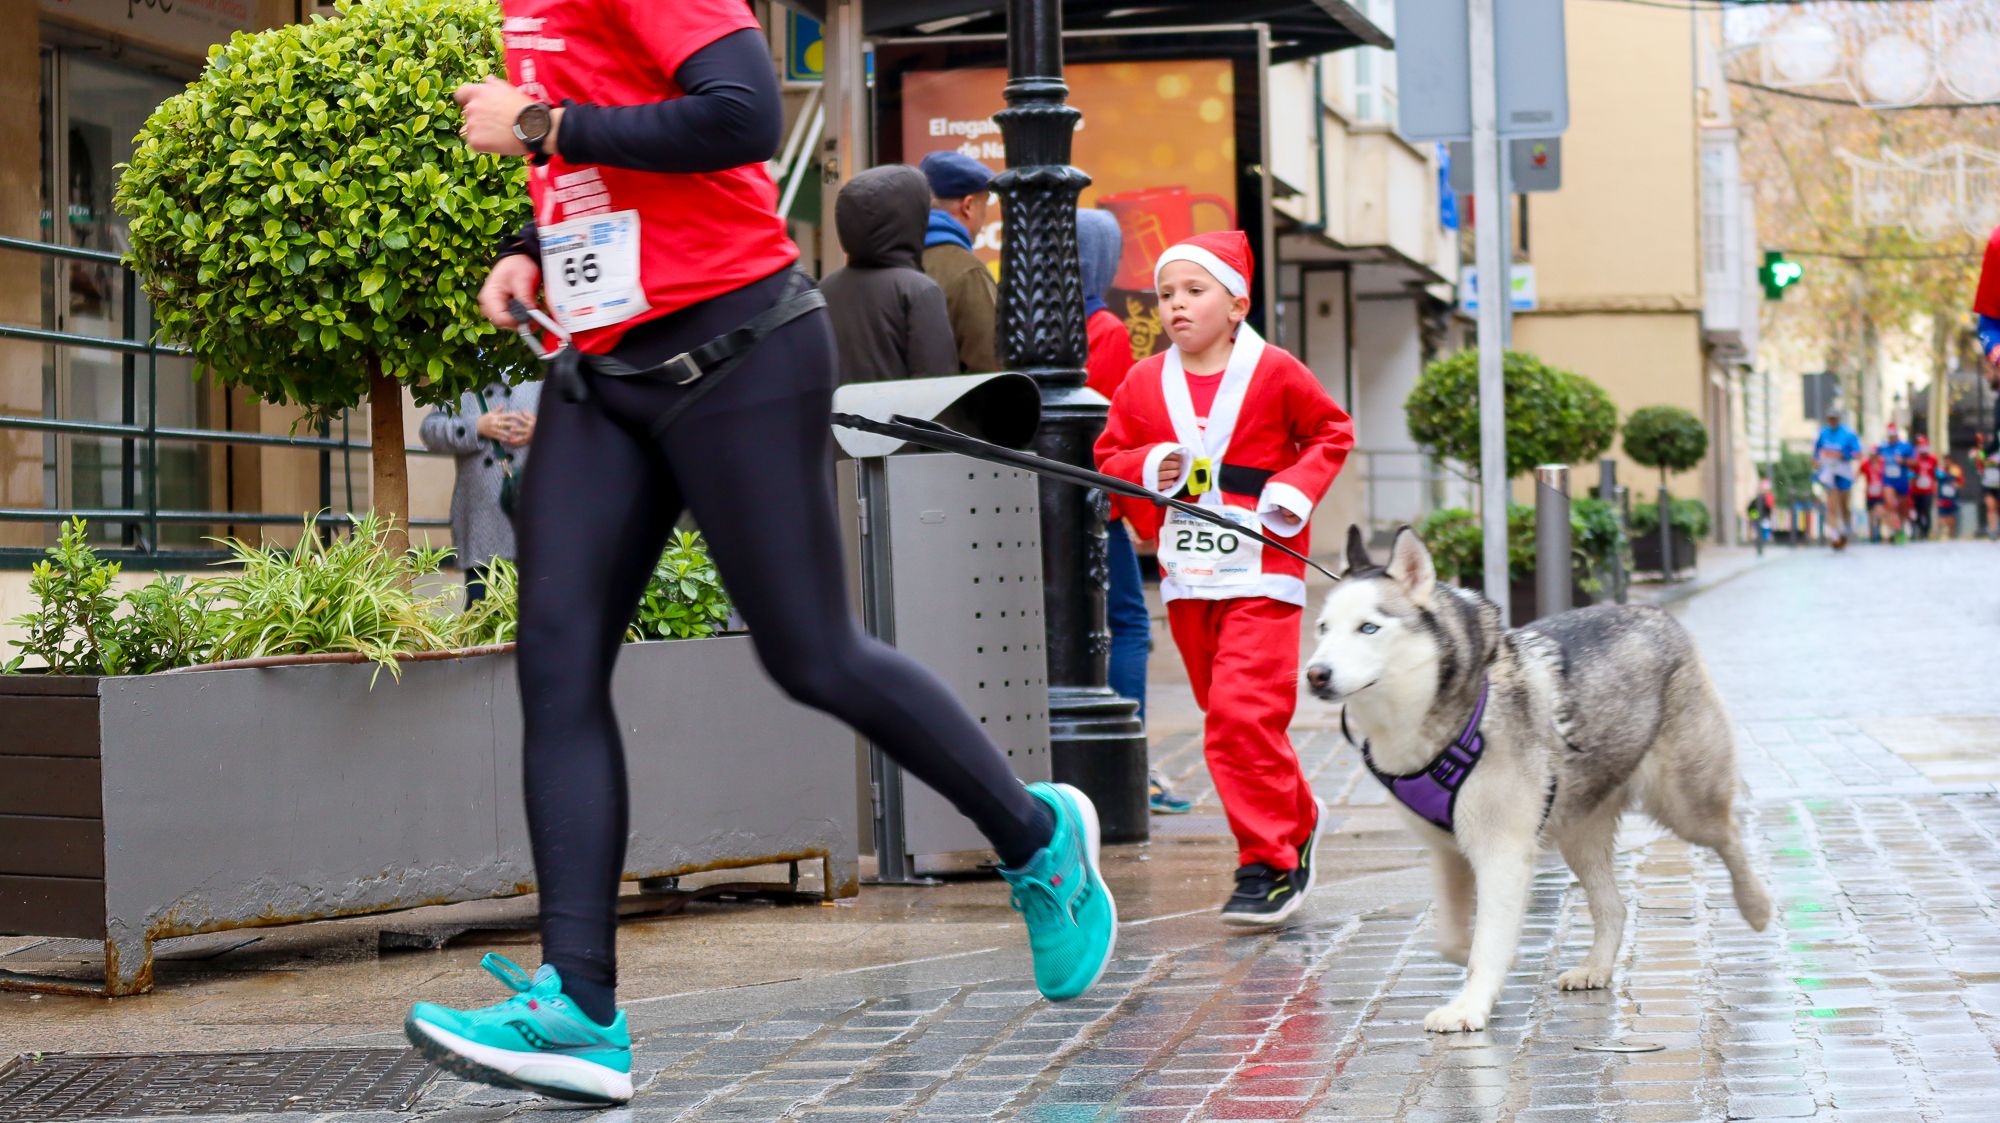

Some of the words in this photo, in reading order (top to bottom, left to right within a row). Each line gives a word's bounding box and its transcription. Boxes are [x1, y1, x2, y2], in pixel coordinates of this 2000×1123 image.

[929, 118, 947, 136] El
[949, 117, 1003, 139] regal
[957, 142, 981, 159] de
[563, 253, 601, 287] 66
[1176, 529, 1239, 555] 250
